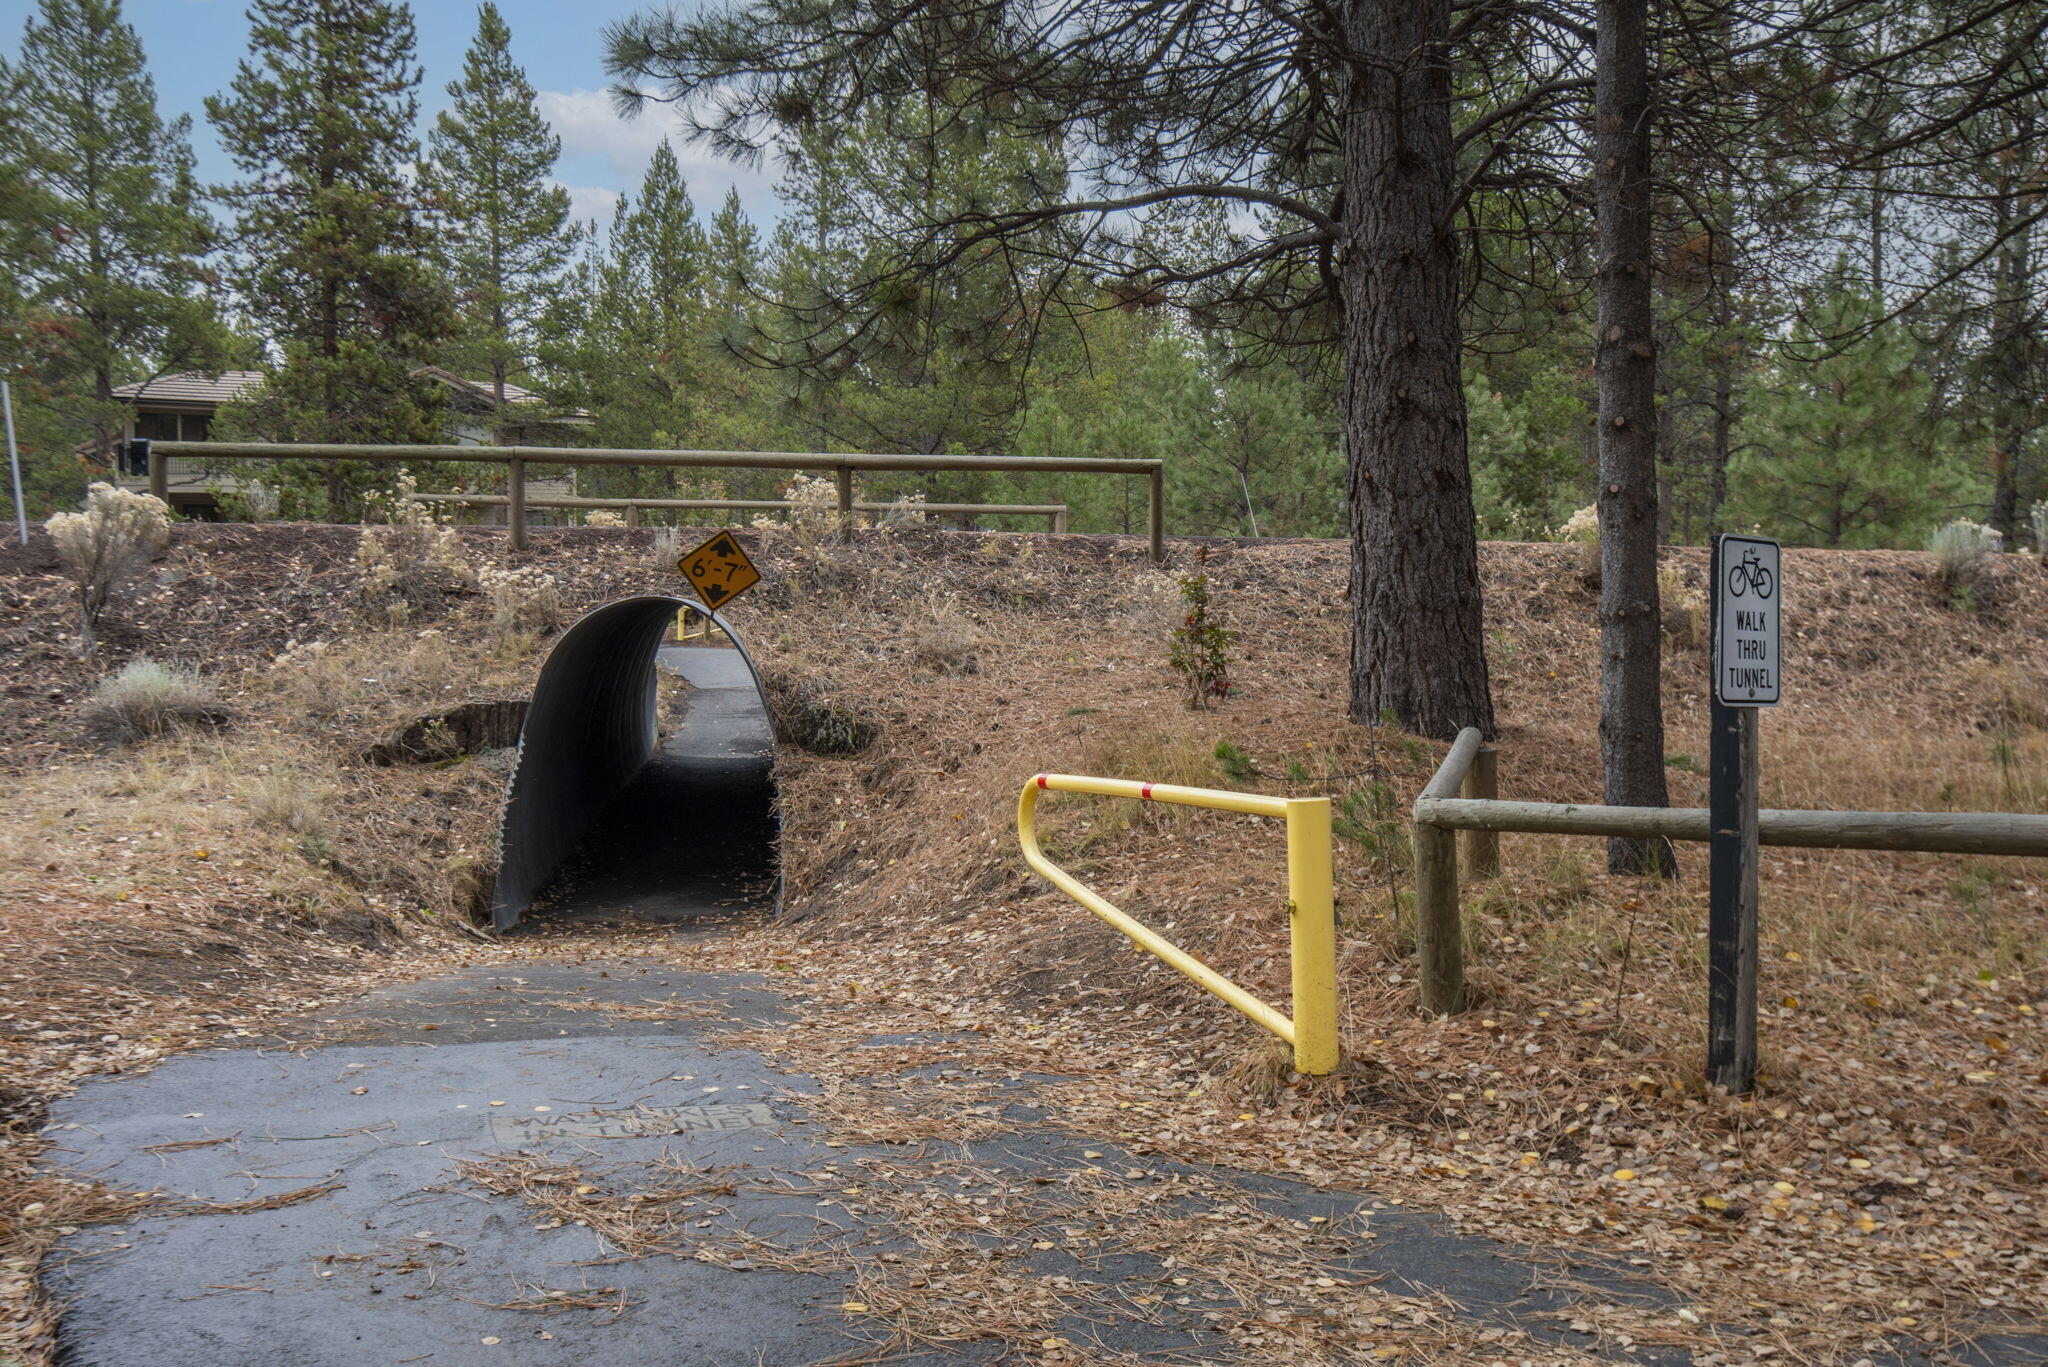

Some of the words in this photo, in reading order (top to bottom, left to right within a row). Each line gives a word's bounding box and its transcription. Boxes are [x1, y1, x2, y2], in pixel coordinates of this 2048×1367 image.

[1736, 610, 1766, 632] WALK
[1736, 639, 1766, 660] THRU
[1729, 668, 1773, 688] TUNNEL
